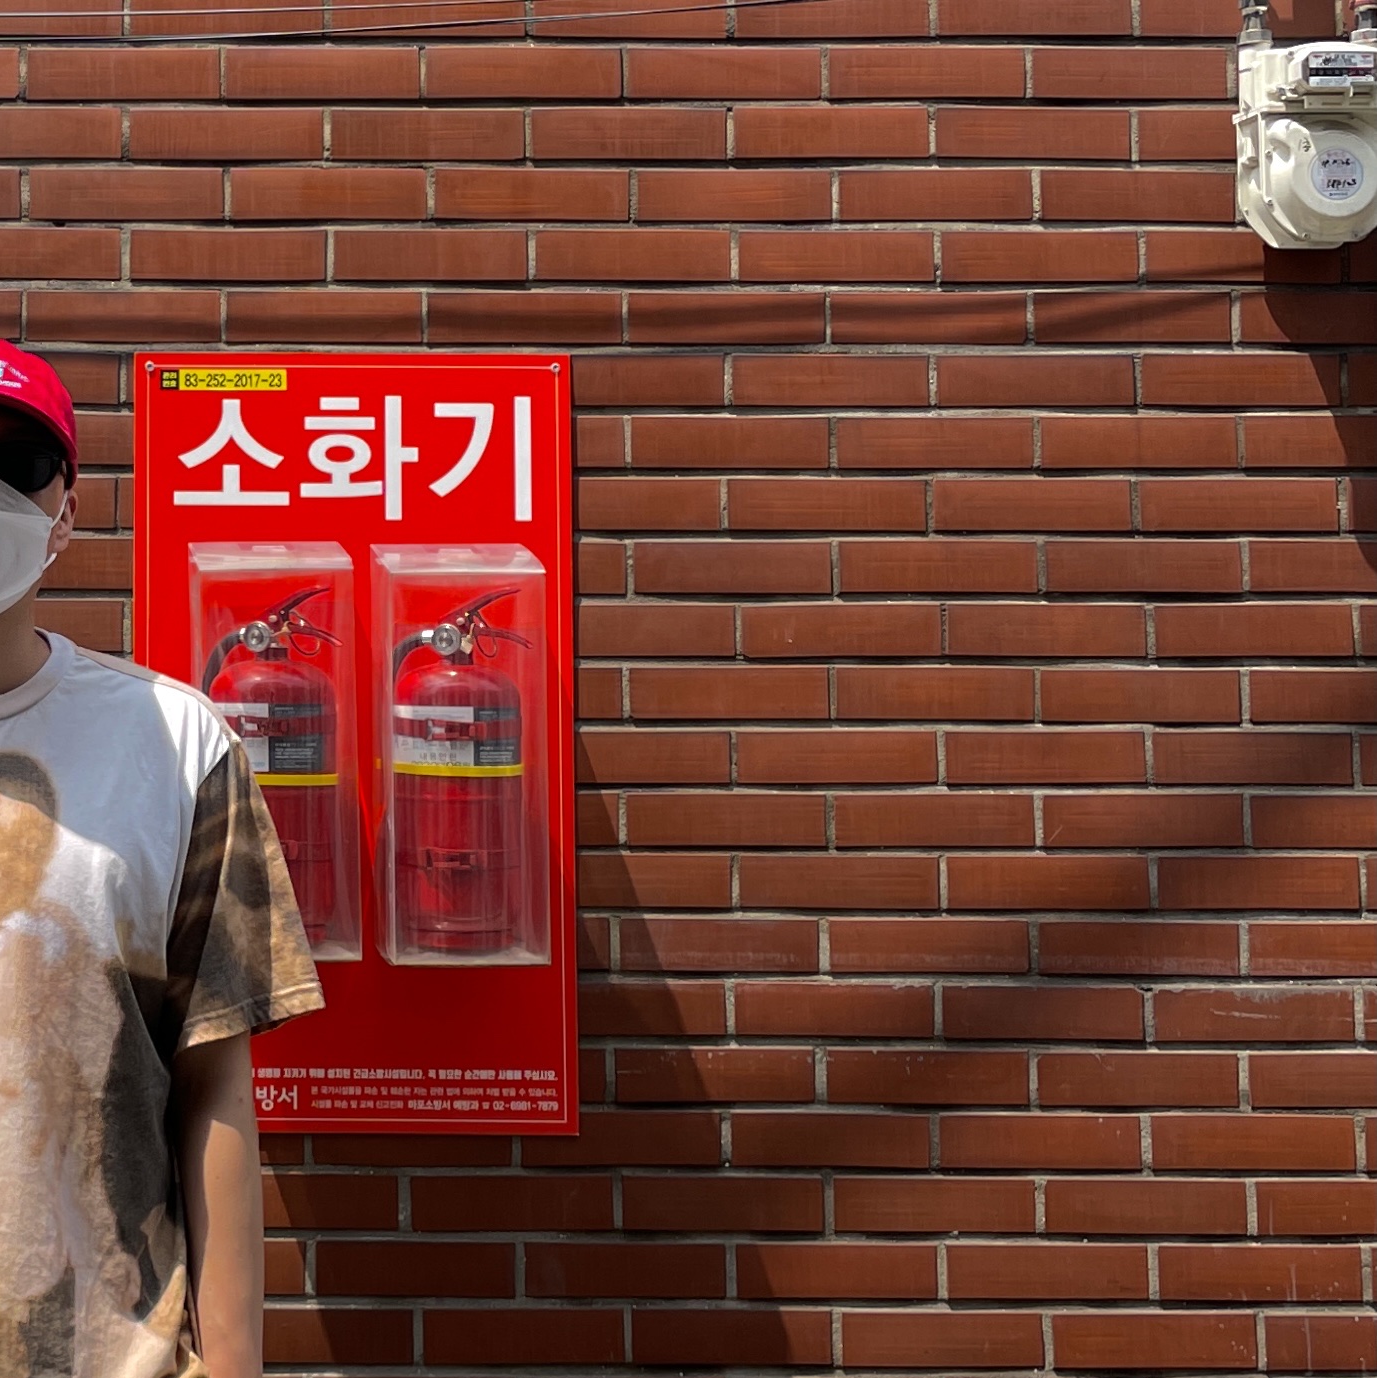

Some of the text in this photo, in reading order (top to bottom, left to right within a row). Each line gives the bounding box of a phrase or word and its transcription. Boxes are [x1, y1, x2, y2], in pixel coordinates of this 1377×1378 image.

[184, 373, 282, 388] 83-252-2017-23
[173, 395, 532, 522] 소화기
[255, 1085, 298, 1111] 방서
